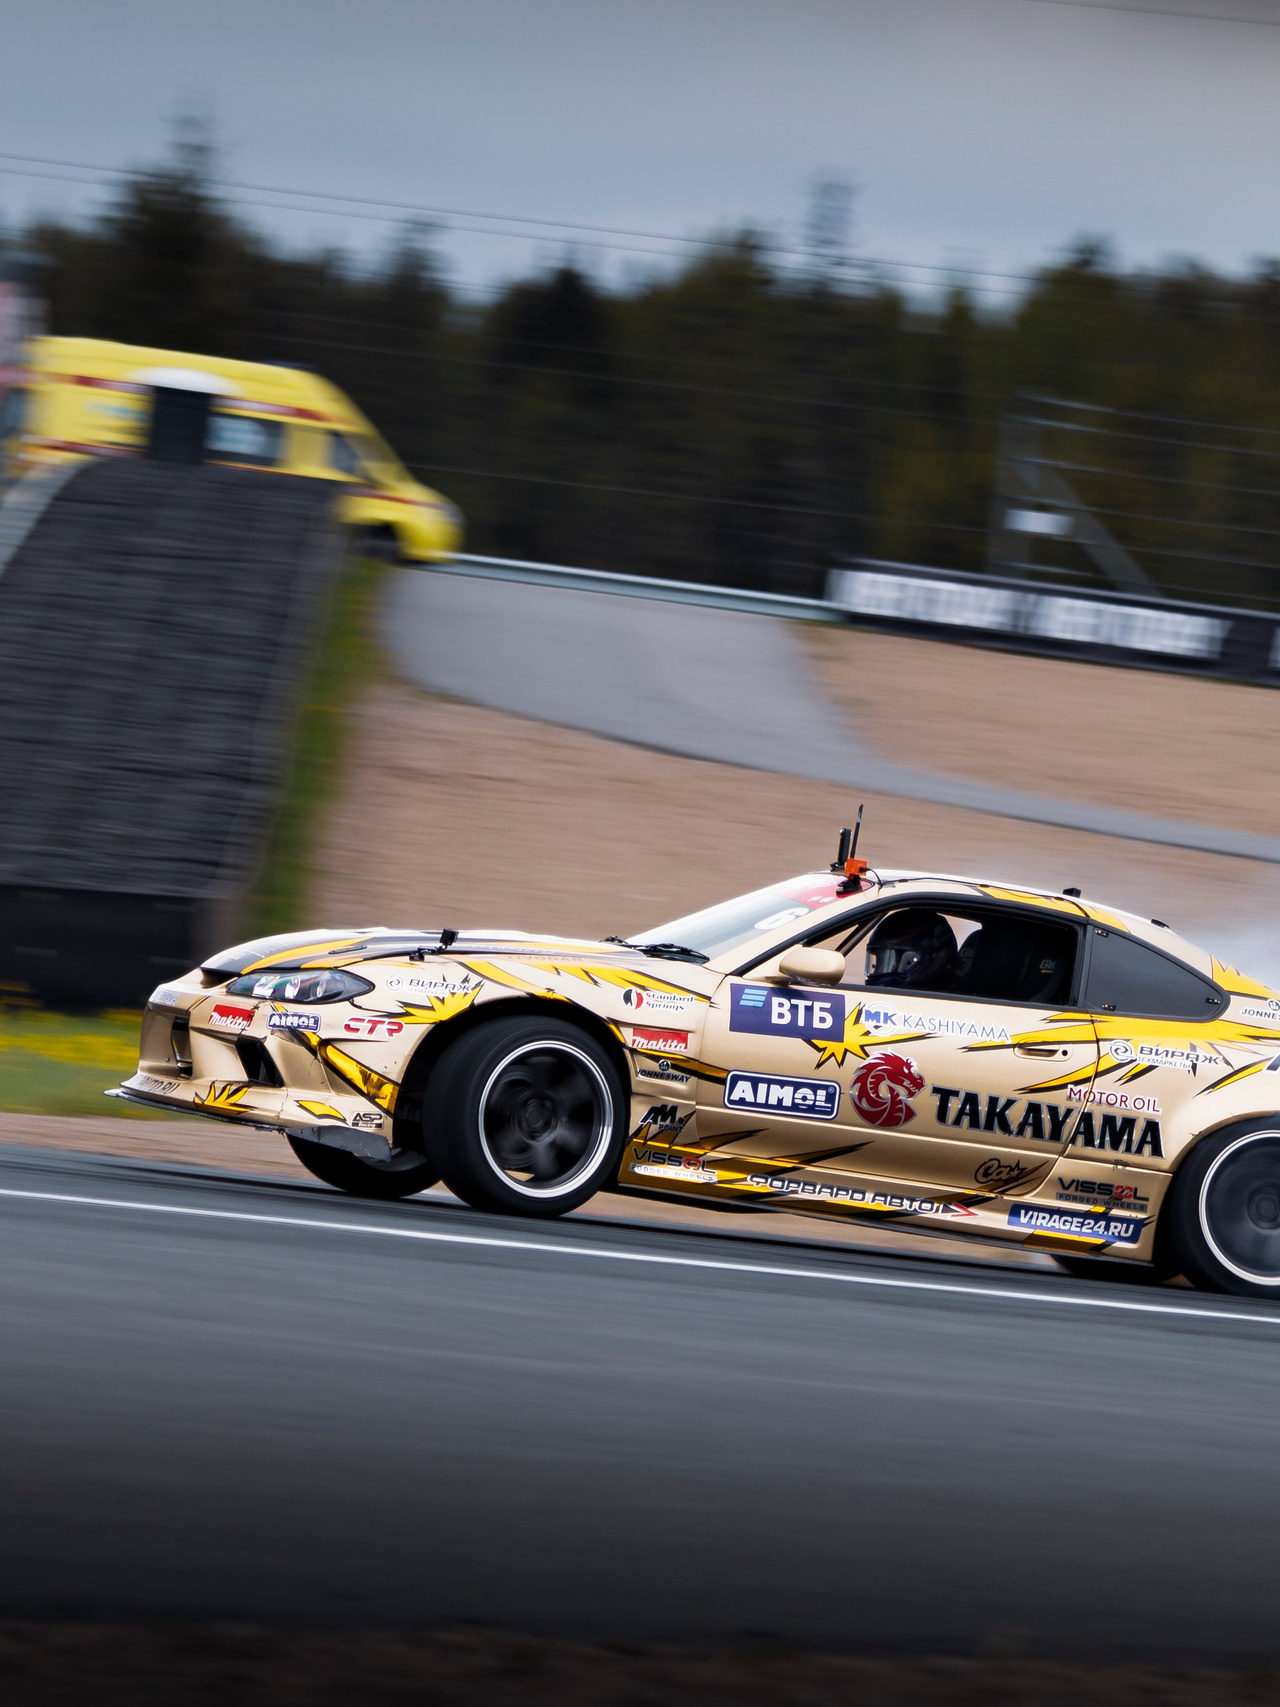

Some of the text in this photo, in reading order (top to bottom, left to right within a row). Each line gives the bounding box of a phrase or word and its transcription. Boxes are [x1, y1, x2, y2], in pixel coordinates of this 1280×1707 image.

[409, 978, 472, 992] ВИРАЖ
[646, 993, 694, 1003] Standard
[646, 1001, 684, 1011] Springs
[270, 1014, 317, 1028] AIMOL
[771, 996, 833, 1029] ВТБ
[344, 1018, 403, 1037] CTR
[864, 1009, 1009, 1042] MK KASHIYAMA
[1138, 1057, 1190, 1068] ТЕХМАРКЕТЫ
[1139, 1046, 1219, 1065] ВИРАЖ
[636, 1068, 691, 1083] JONNESWAY
[729, 1081, 832, 1107] AIMOL
[1068, 1087, 1160, 1112] MOTOR OIL
[353, 1113, 383, 1122] ASP
[931, 1086, 1165, 1158] TAKAYAMA
[659, 1124, 684, 1132] POINT
[632, 1164, 714, 1182] FORGED WHEELS
[749, 1174, 935, 1212] ФОРВАРД АВТО
[1058, 1194, 1146, 1211] FORGED WHEELS
[1019, 1209, 1135, 1238] VIRAGE24.RU
